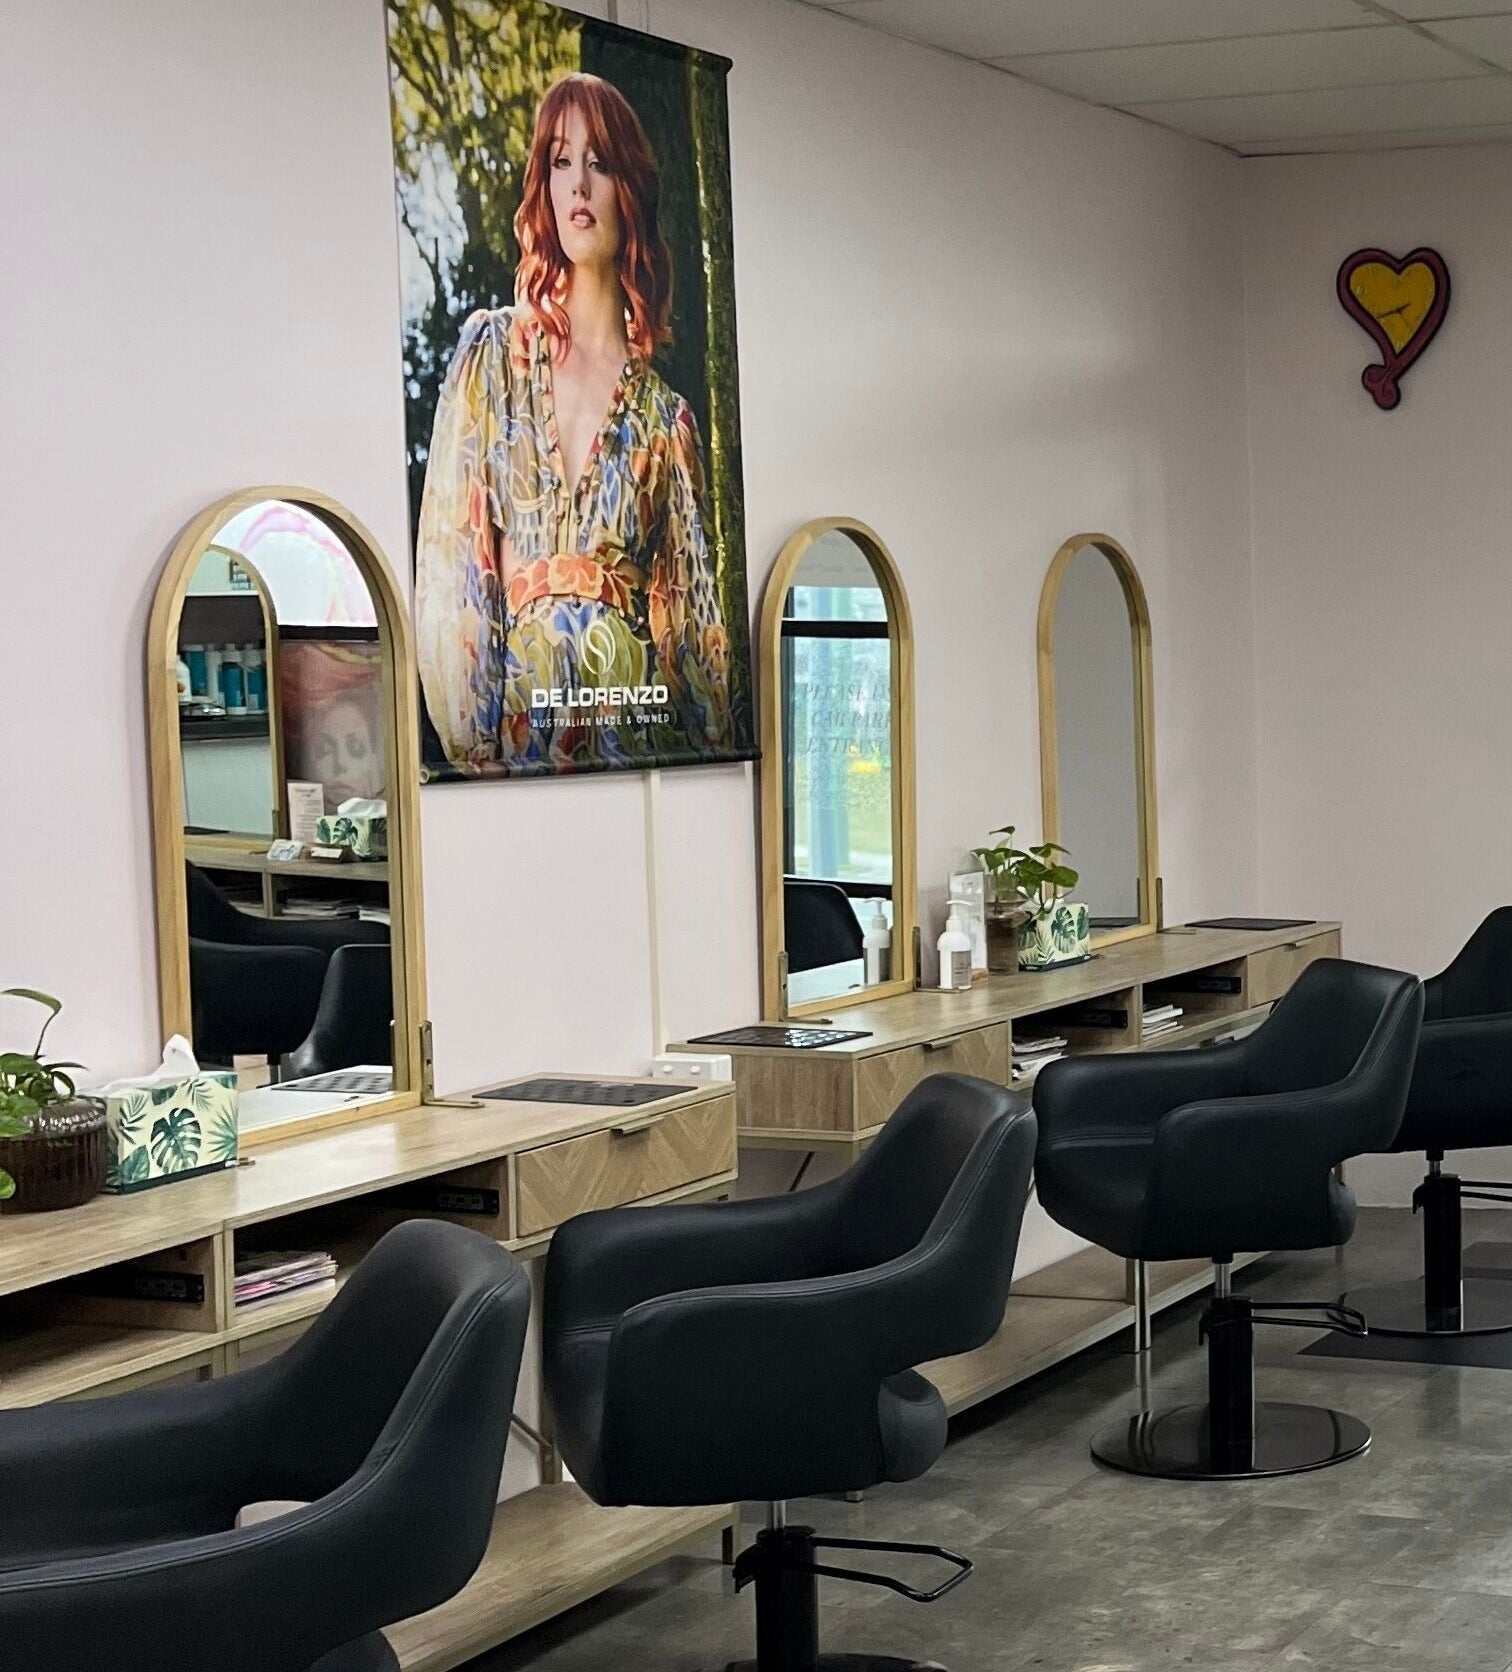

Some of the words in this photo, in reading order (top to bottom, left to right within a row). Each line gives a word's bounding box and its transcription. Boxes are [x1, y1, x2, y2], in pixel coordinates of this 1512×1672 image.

[531, 687, 563, 708] DE
[567, 684, 669, 707] LORENZO
[532, 717, 592, 728] AUSTRALIAN
[595, 715, 622, 726] MADE
[636, 713, 670, 725] OWNED
